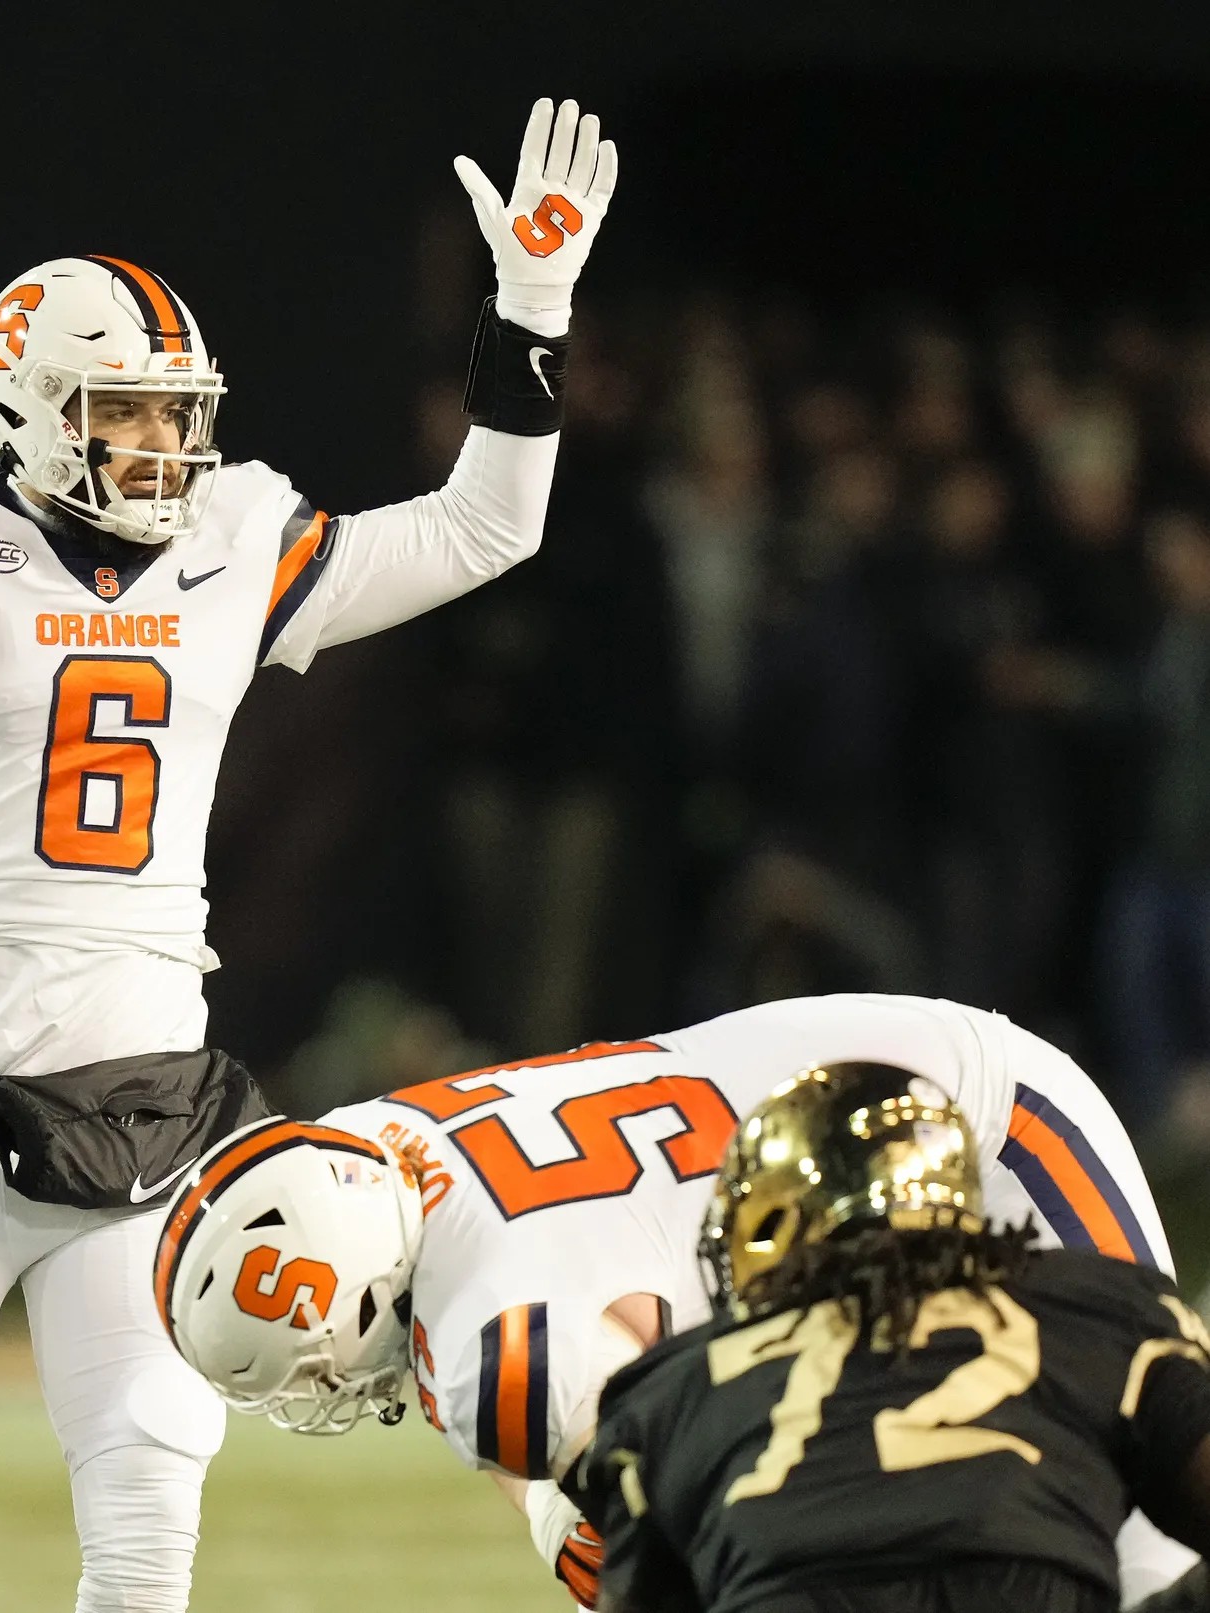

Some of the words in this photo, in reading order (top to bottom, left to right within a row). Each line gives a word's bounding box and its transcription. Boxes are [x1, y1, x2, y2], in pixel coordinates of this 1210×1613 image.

[512, 194, 583, 258] S
[166, 357, 194, 368] ACC
[94, 567, 120, 598] S
[35, 613, 180, 647] ORANGE
[34, 654, 171, 875] 6
[232, 1244, 338, 1331] S
[707, 1285, 1042, 1508] 72
